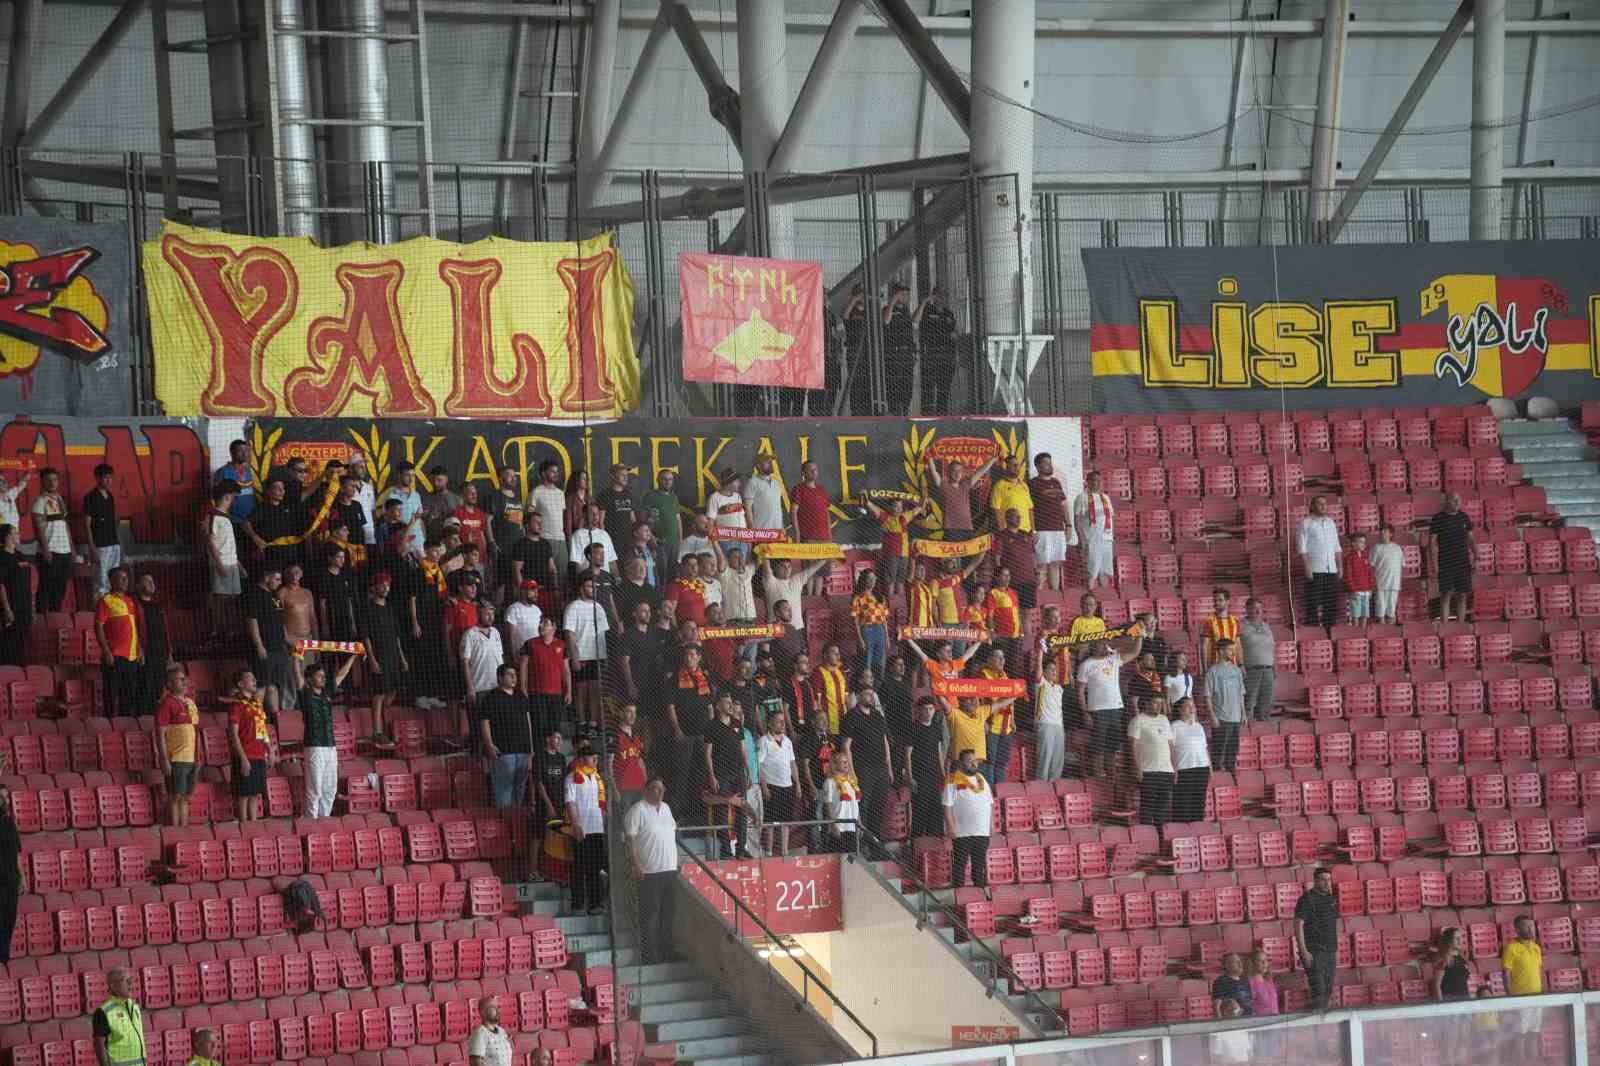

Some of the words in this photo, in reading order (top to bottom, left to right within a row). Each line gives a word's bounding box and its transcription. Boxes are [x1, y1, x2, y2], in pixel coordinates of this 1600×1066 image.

[161, 233, 621, 419] YALI
[400, 427, 866, 507] KADİFEKAE
[775, 879, 820, 912] 221
